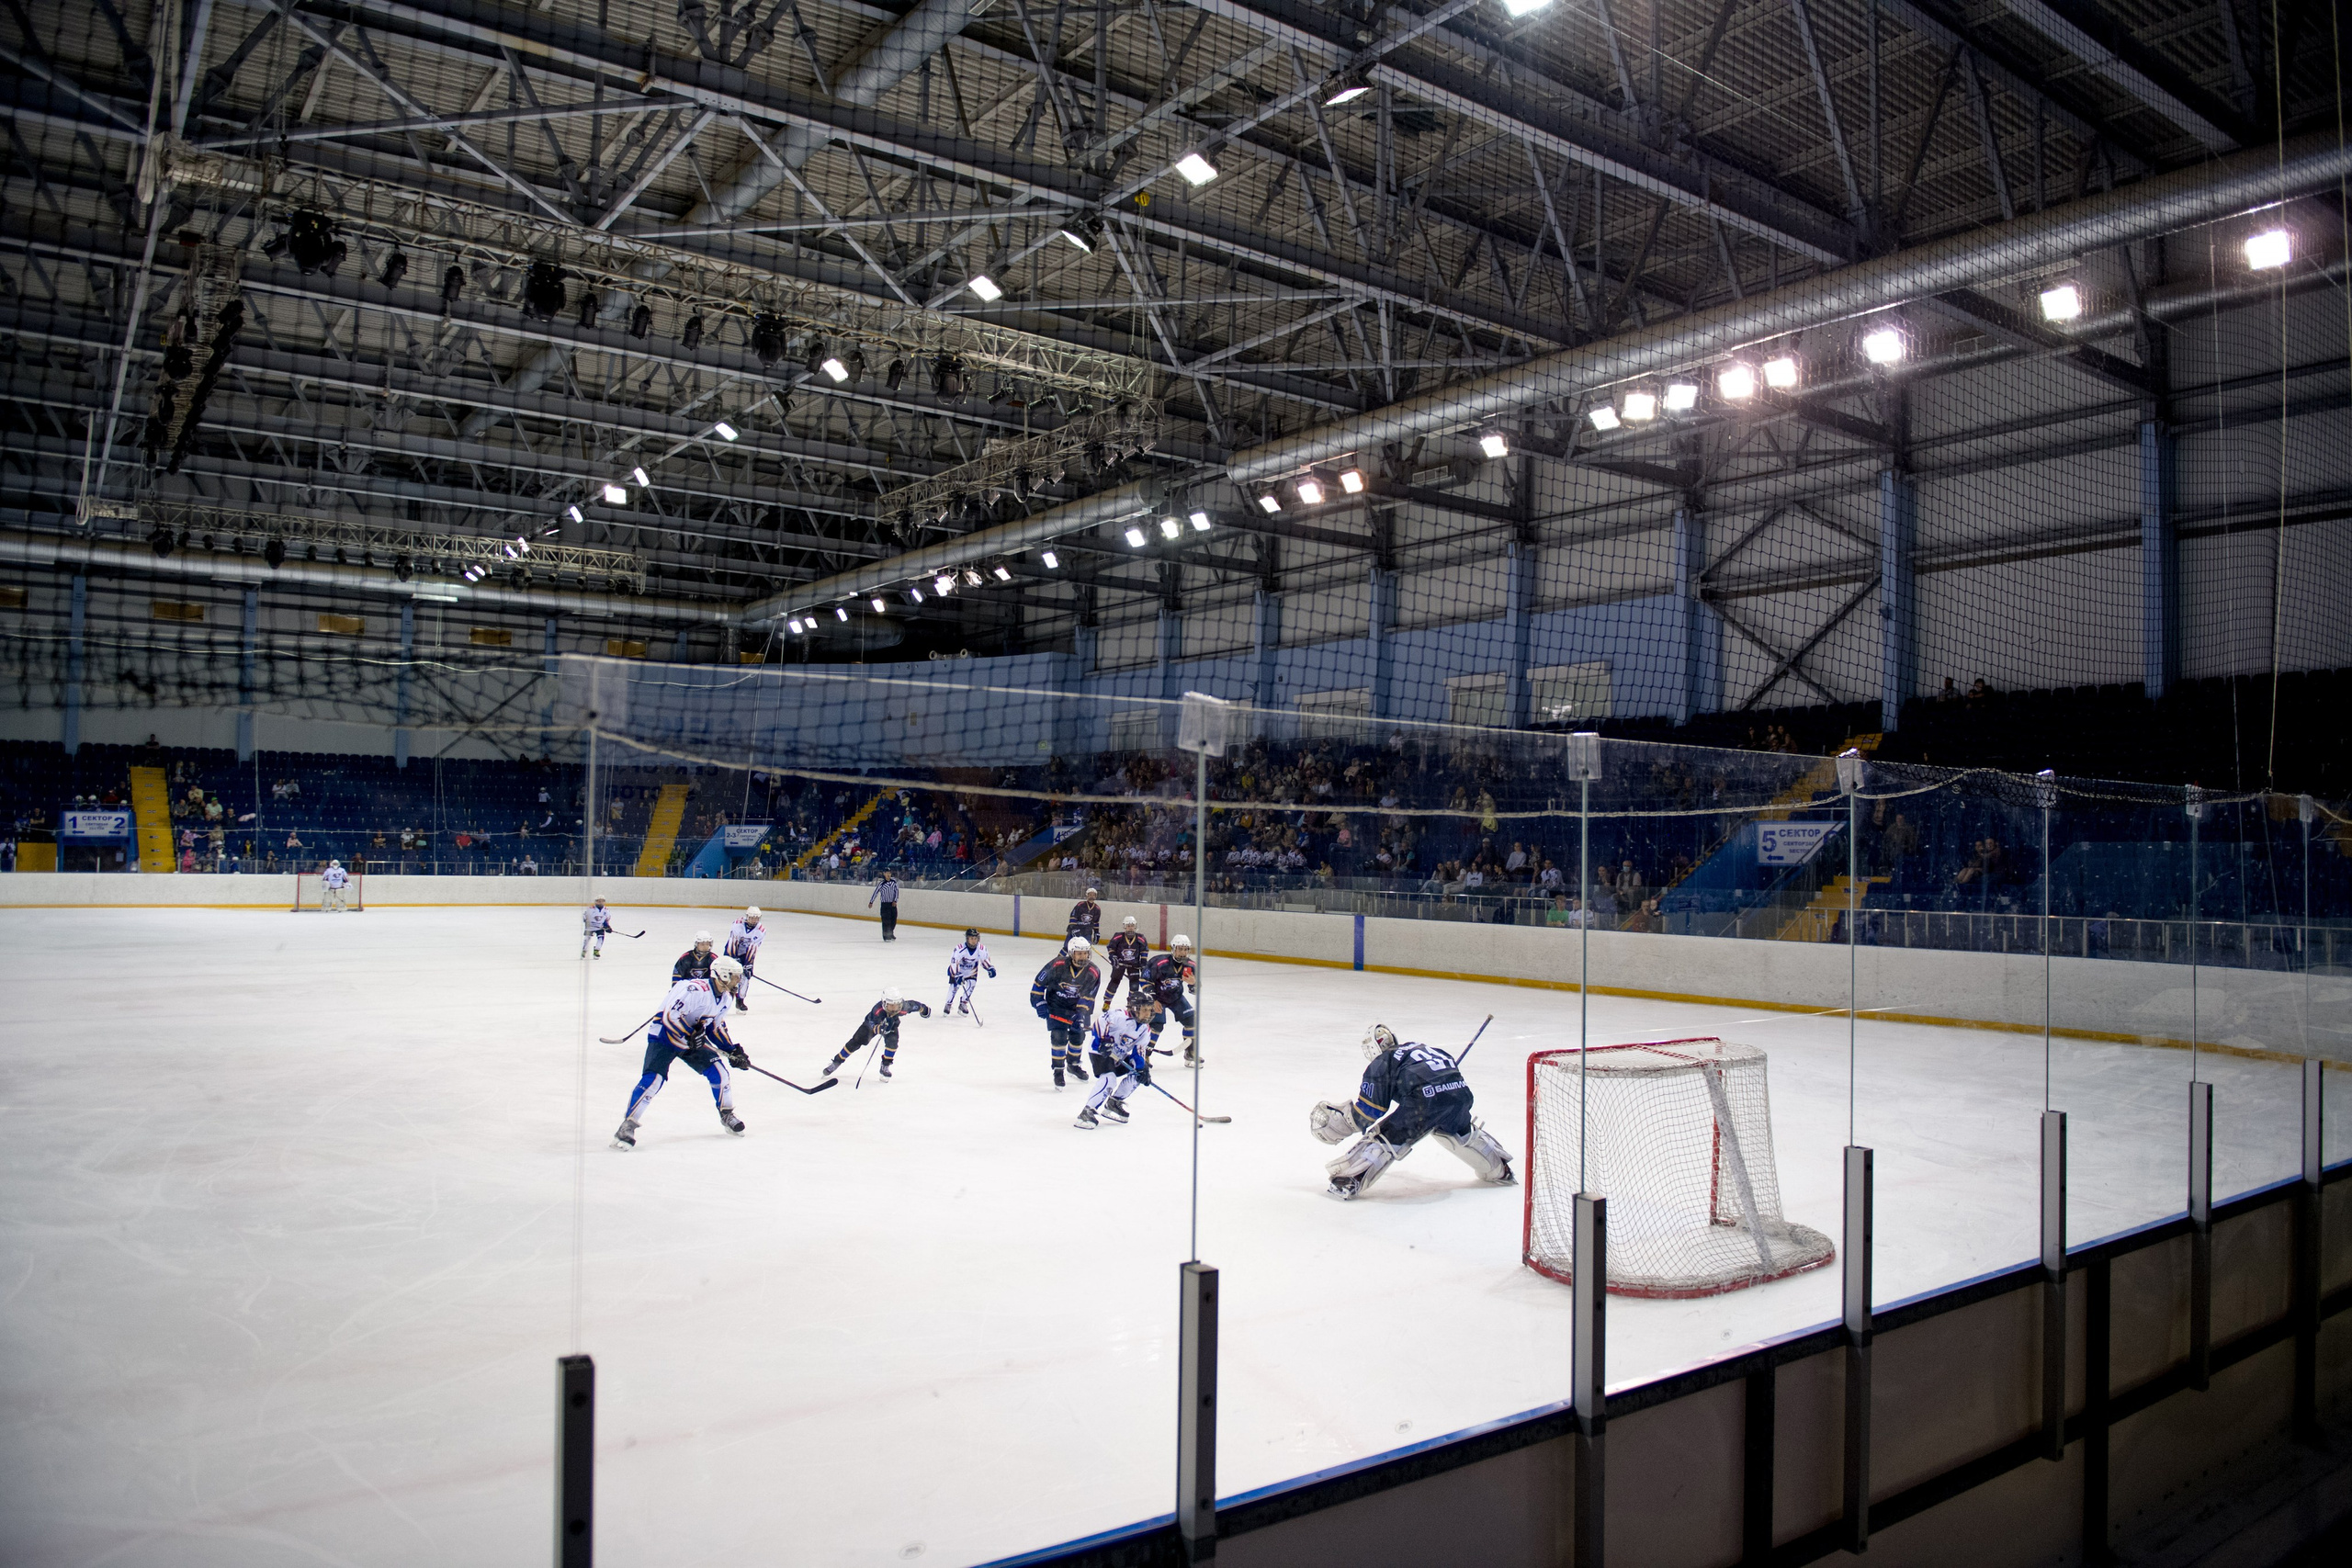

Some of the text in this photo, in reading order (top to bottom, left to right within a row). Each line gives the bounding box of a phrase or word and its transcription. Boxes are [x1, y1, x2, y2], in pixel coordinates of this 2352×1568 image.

[68, 816, 77, 829] 1
[113, 817, 126, 829] 2
[1761, 829, 1820, 852] 5 СЕКТОР
[1409, 1045, 1455, 1072] 31
